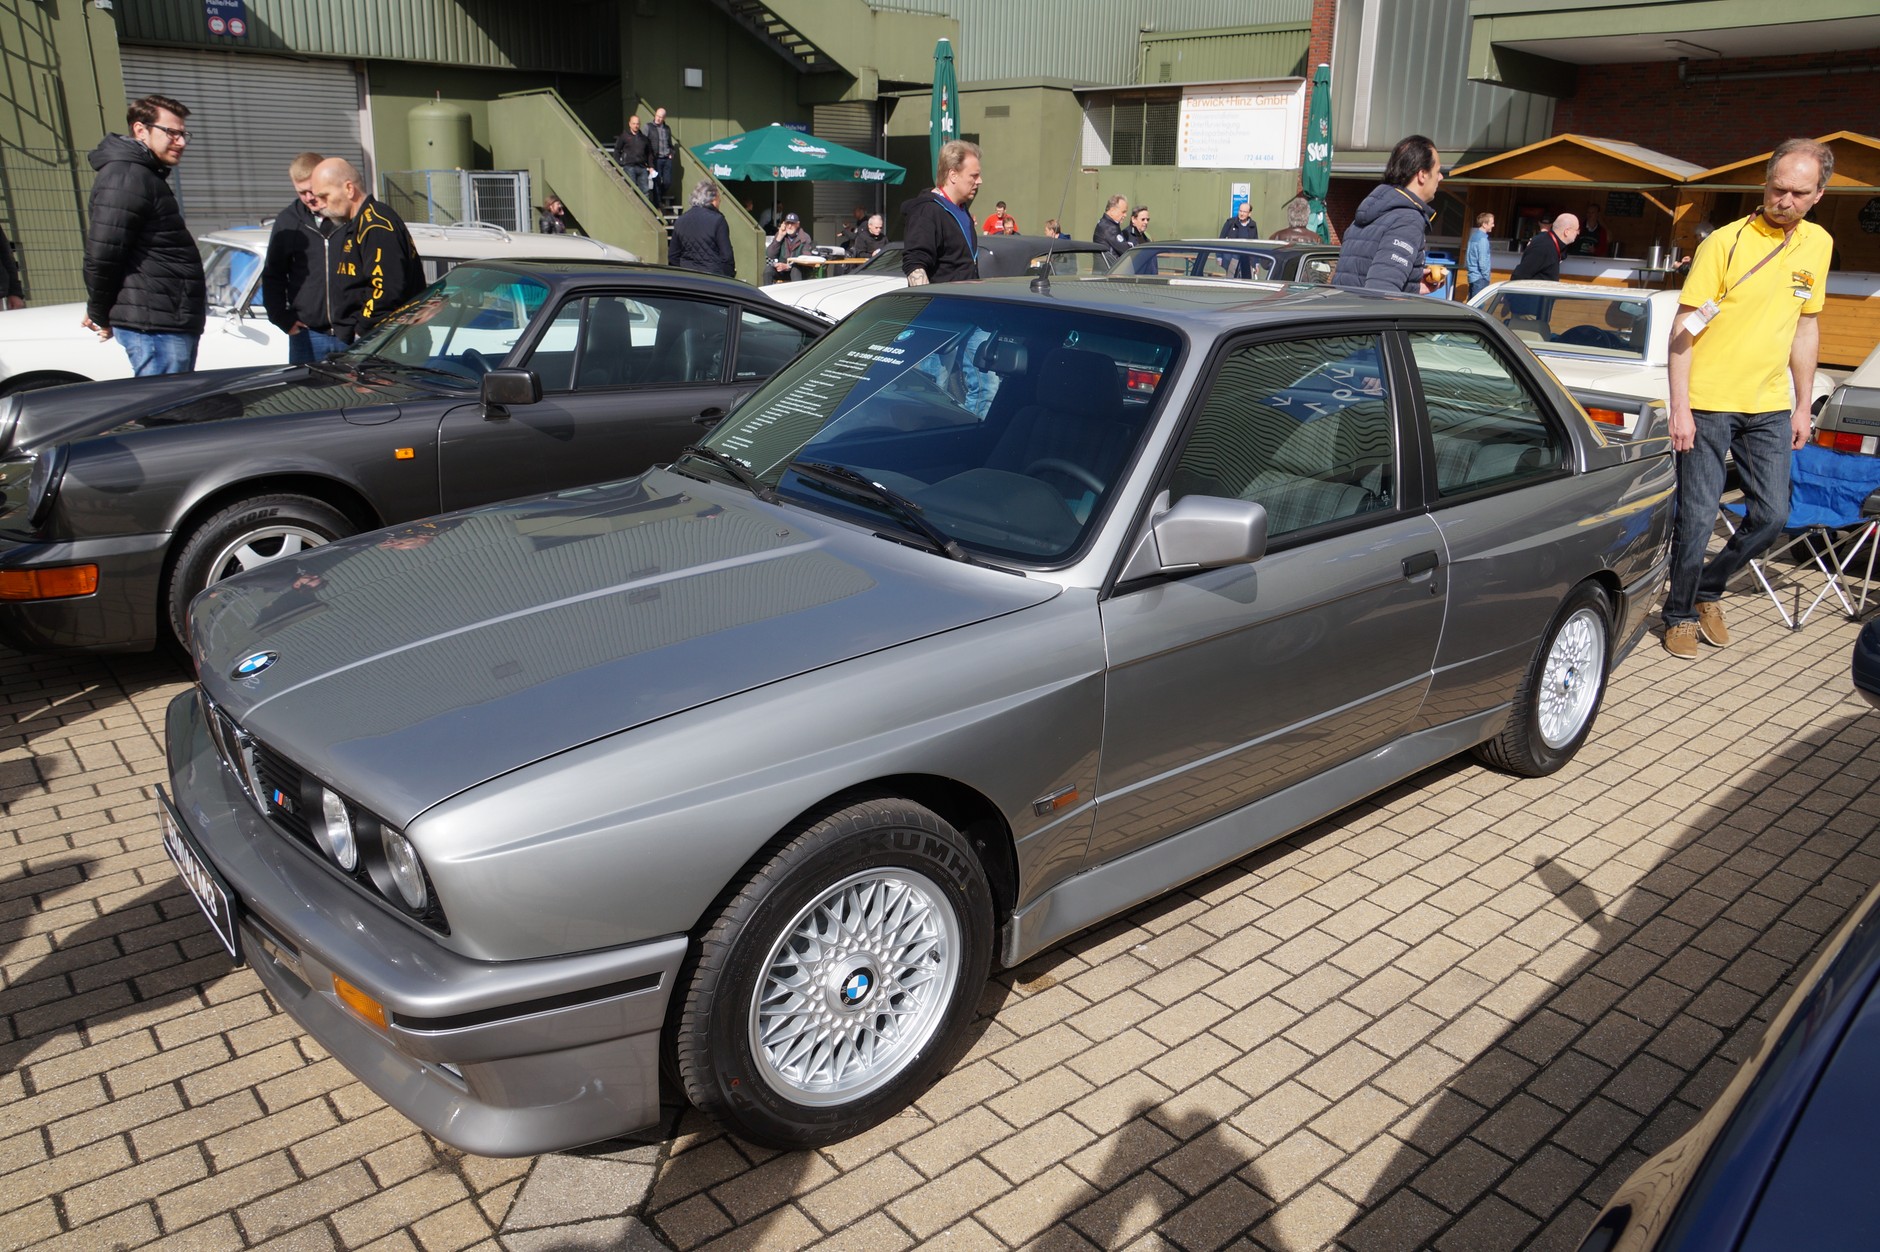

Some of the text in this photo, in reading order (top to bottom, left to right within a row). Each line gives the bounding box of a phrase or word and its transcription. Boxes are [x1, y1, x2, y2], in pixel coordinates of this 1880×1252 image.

[1256, 95, 1288, 106] GmbH
[780, 166, 806, 178] Stauder
[861, 169, 885, 180] Stauder
[167, 817, 218, 917] BMW M3
